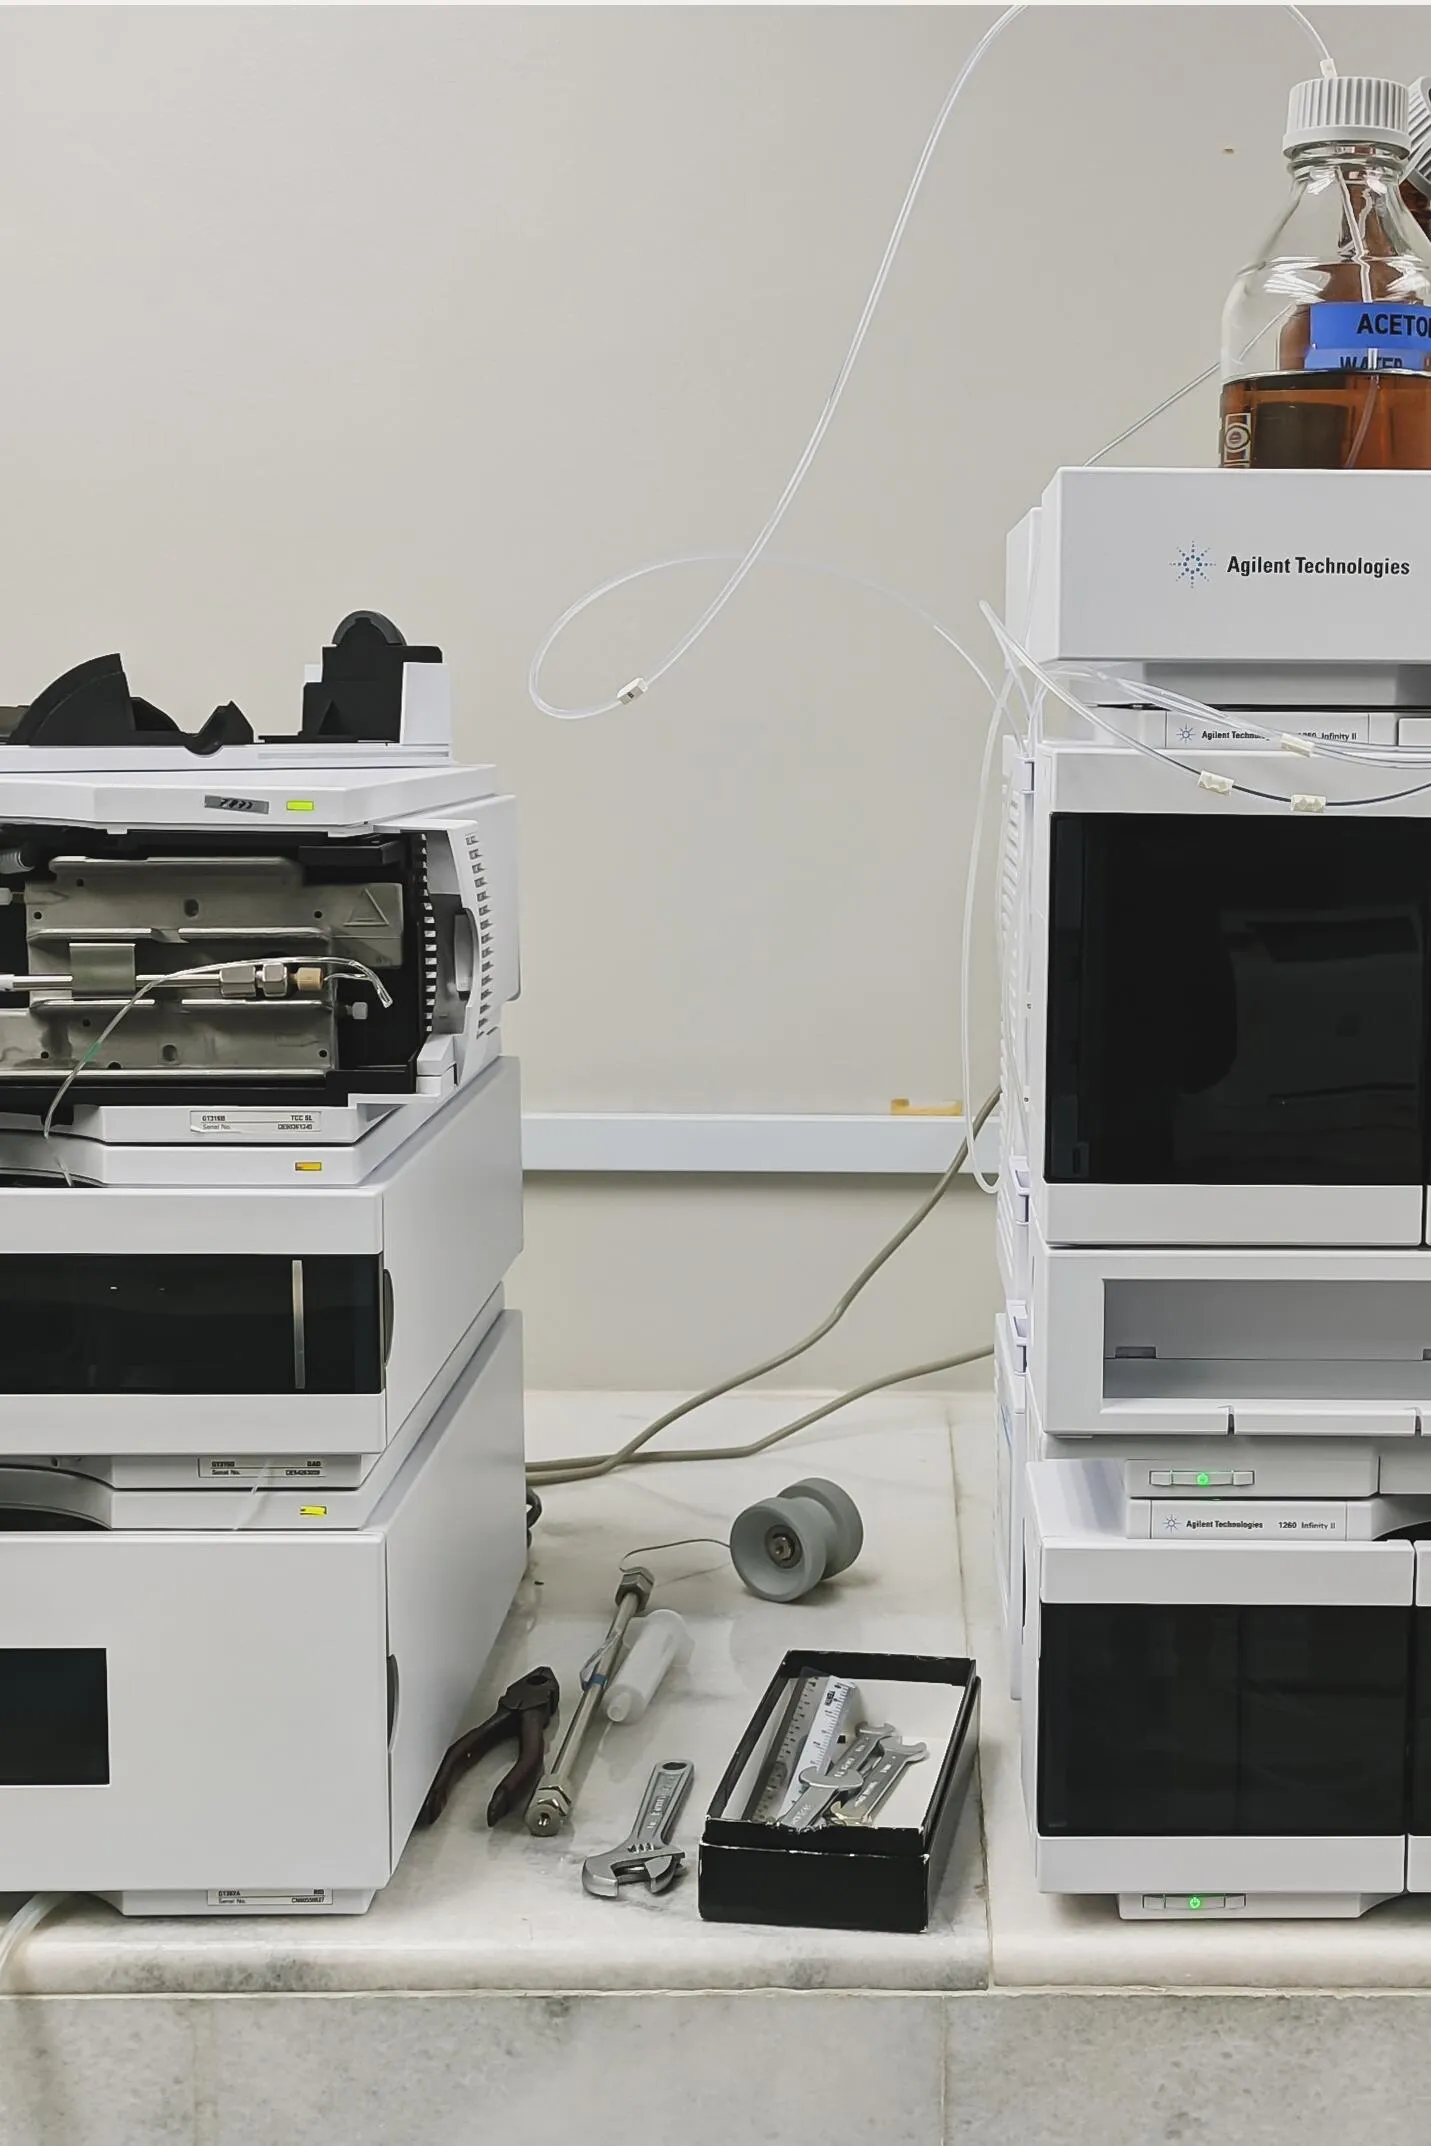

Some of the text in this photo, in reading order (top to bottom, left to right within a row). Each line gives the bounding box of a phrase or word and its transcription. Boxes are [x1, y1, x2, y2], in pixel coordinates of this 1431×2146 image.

[1356, 313, 1431, 338] ACETO
[1227, 556, 1410, 578] Agilent Technologies
[1201, 730, 1230, 741] Agilent
[1186, 1520, 1214, 1529] Agilent
[1214, 1520, 1263, 1529] Technologies
[1278, 1521, 1297, 1529] 1260
[1301, 1522, 1328, 1530] Infinity
